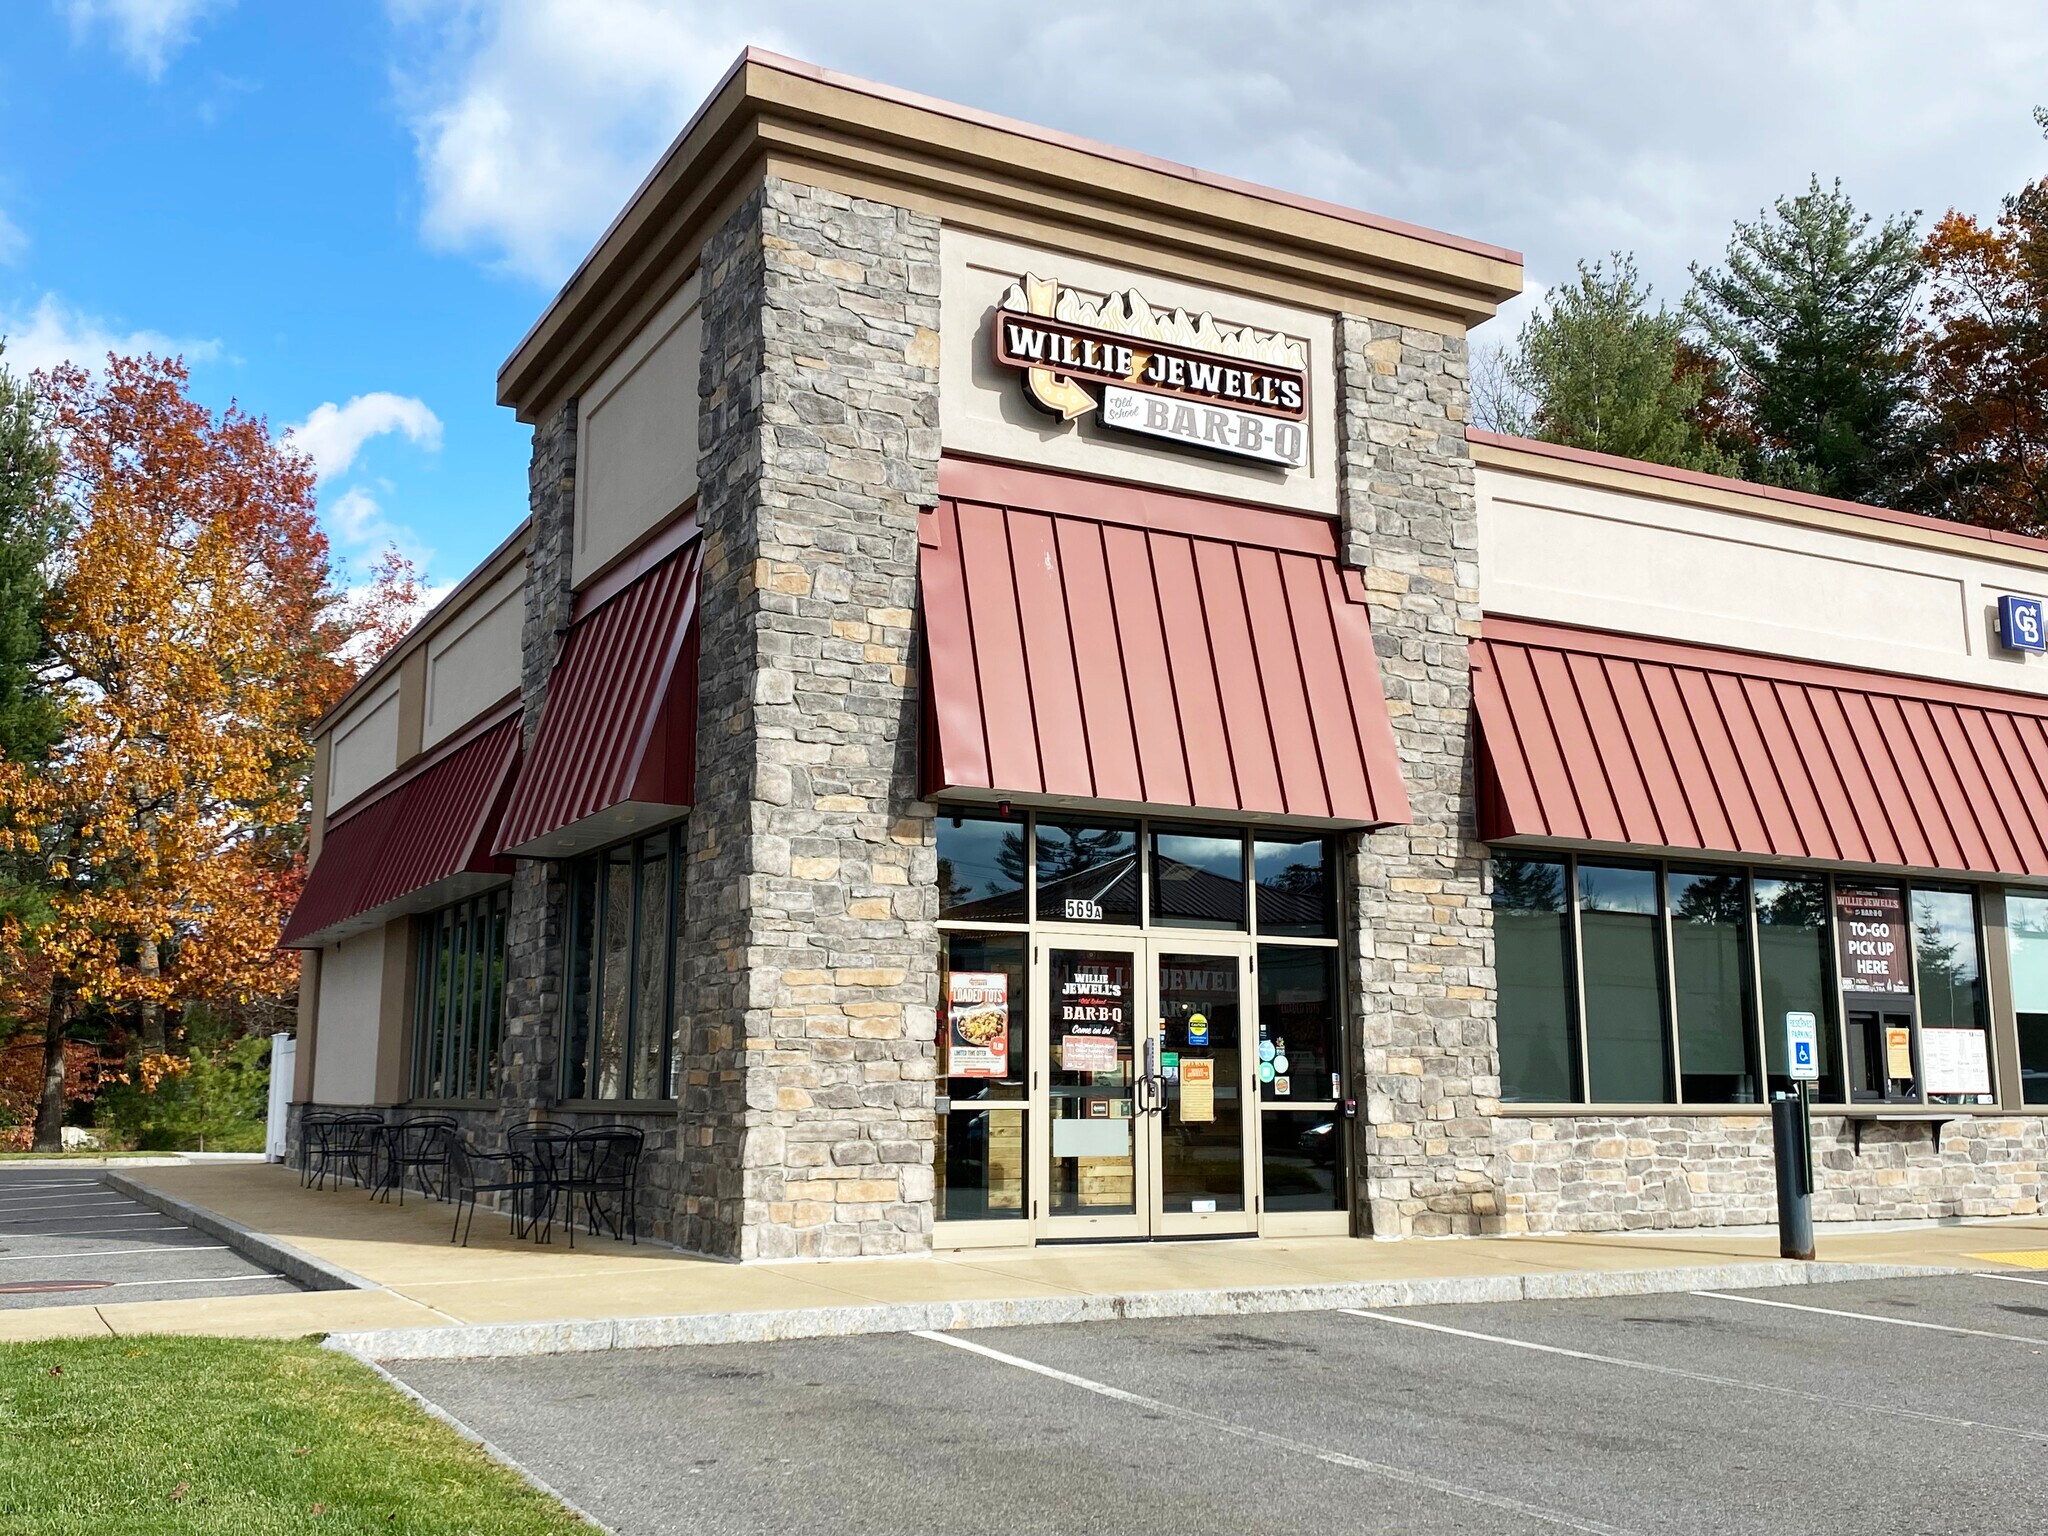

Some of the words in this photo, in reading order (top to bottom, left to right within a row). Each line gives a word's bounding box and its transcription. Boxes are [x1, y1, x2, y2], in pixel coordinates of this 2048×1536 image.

[1007, 324, 1133, 375] WILLIE
[1148, 352, 1301, 408] JEWELL'S
[1110, 396, 1133, 408] Old
[1108, 407, 1139, 420] School
[1143, 398, 1301, 464] BAR-B-Q
[1836, 896, 1863, 907] WILLIE
[1849, 922, 1890, 938] TO-GO
[1848, 940, 1876, 956] PICK
[1877, 941, 1895, 956] UP
[1856, 959, 1889, 974] HERE
[1074, 973, 1109, 984] WILLIE
[953, 987, 983, 1003] LOADED
[984, 988, 1003, 1003] TOTS
[1062, 982, 1121, 997] JEWELL'S
[1062, 1006, 1122, 1023] BAR-B-Q
[1072, 1024, 1091, 1034] Come
[1102, 1025, 1114, 1034] in!
[1790, 1020, 1813, 1028] RESERVED
[1791, 1030, 1813, 1039] PARKING
